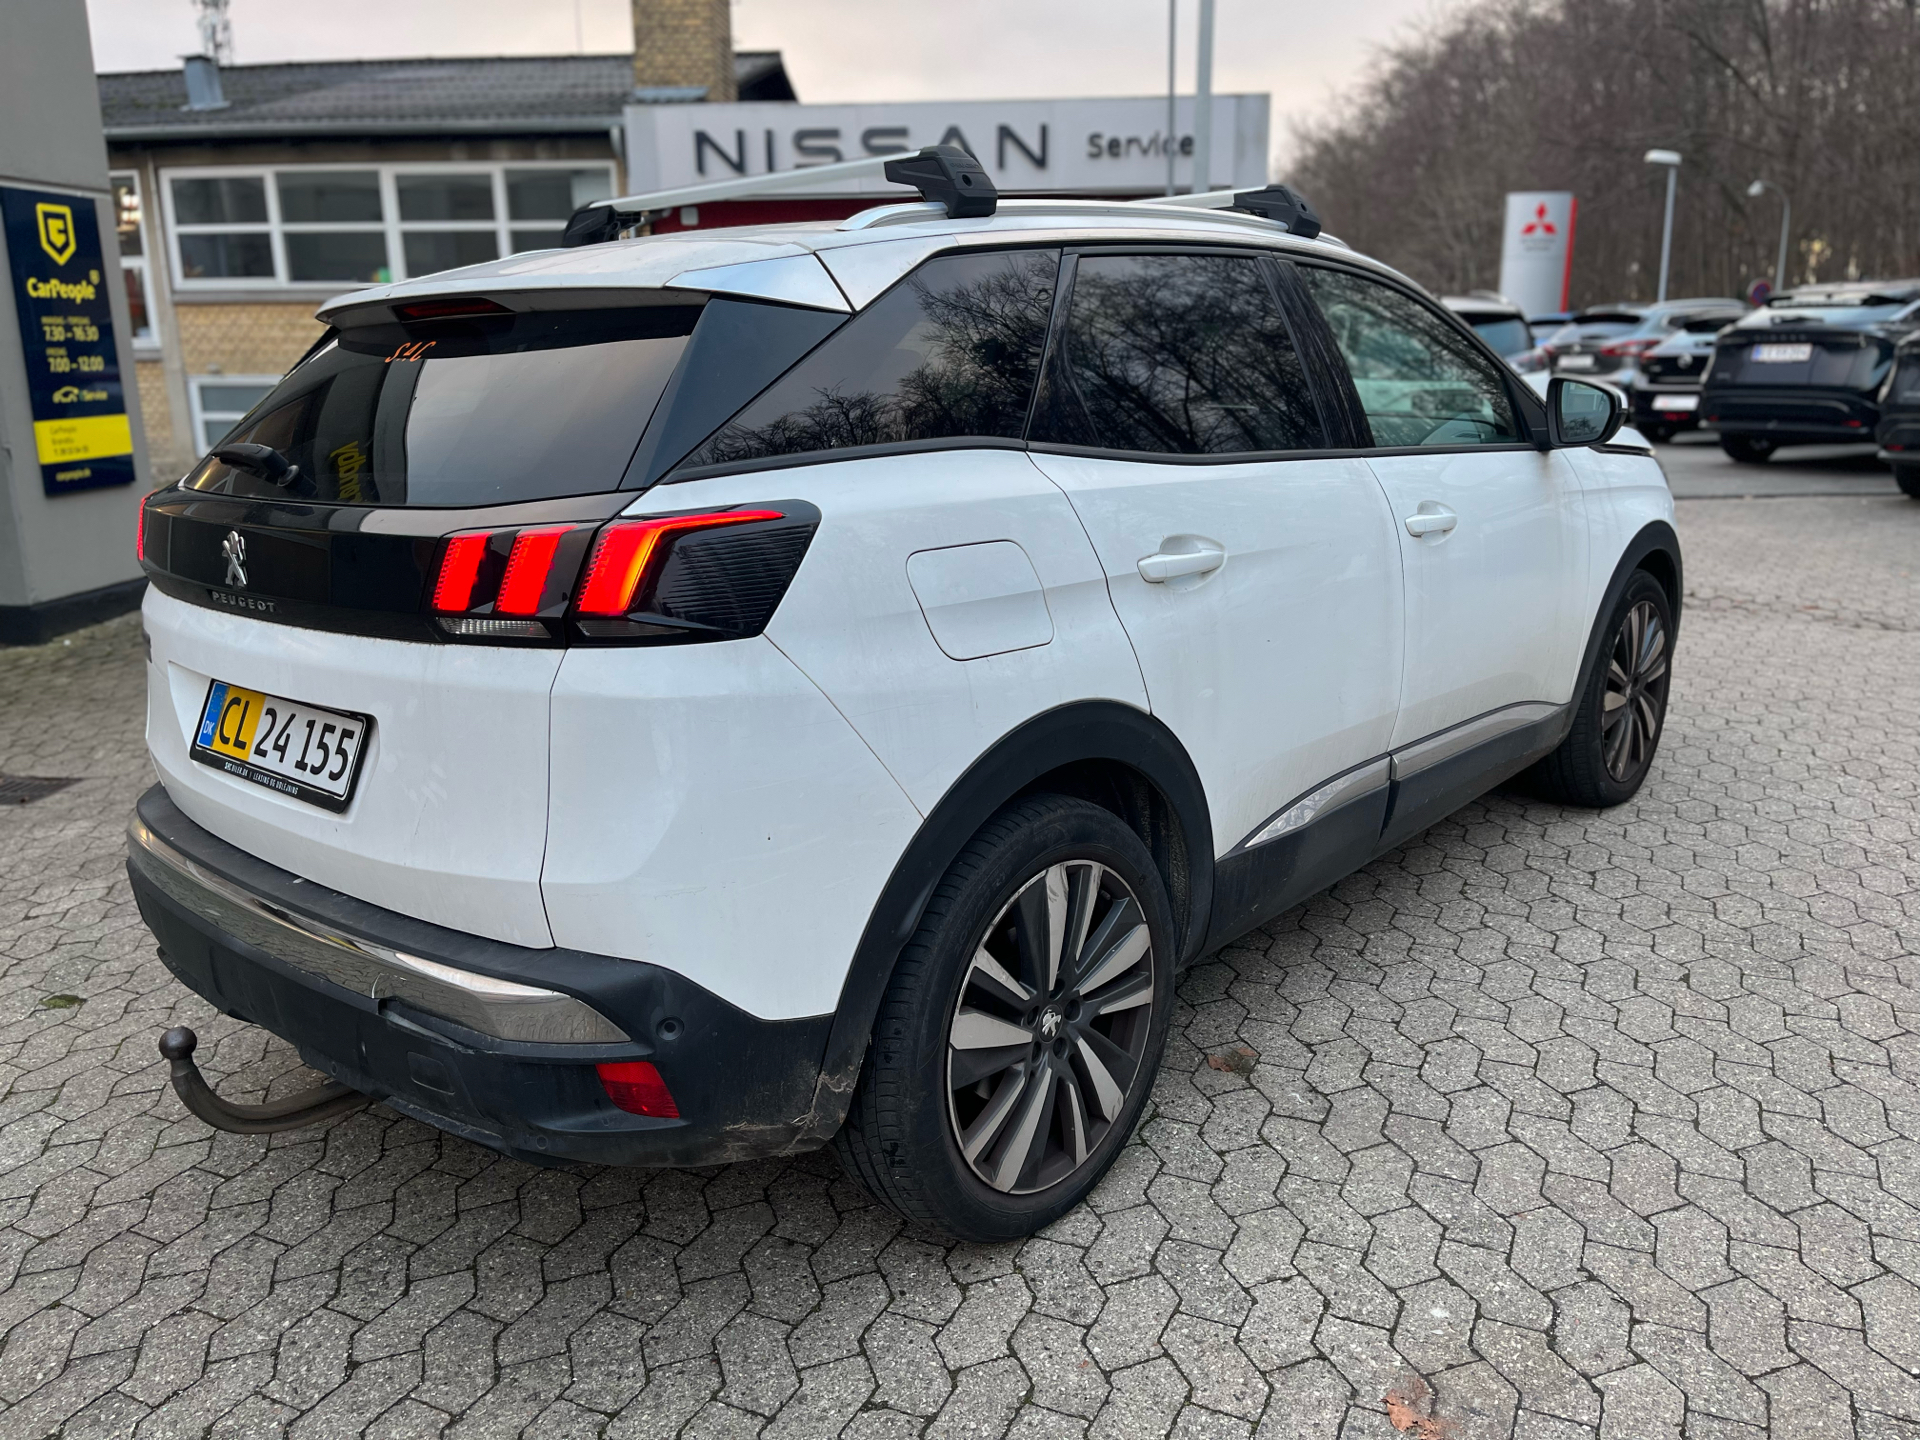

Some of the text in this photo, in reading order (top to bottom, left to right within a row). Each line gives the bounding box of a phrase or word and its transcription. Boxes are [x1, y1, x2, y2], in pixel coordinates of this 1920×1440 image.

[694, 124, 1194, 176] NISSAN Service
[27, 276, 96, 303] CarPeople
[212, 591, 275, 613] PEUGEOT
[203, 721, 215, 736] DK
[219, 696, 356, 782] CL 24 155
